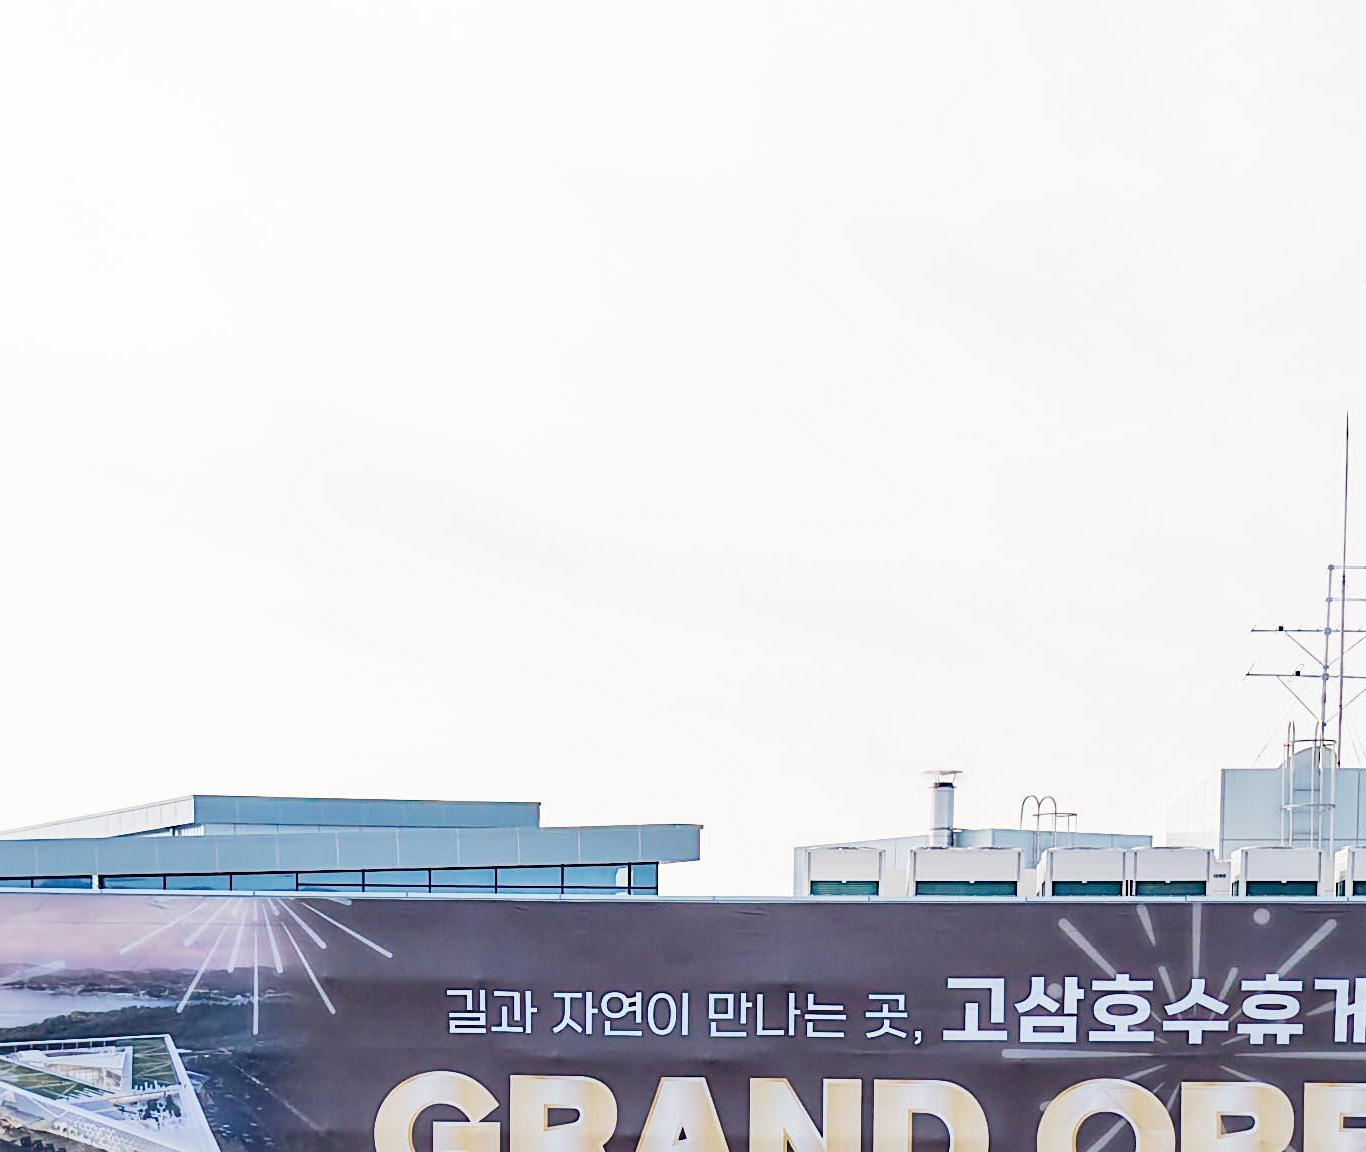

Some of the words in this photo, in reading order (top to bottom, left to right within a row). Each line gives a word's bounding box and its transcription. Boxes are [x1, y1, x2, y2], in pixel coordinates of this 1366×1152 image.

[445, 988, 539, 1035] 길과
[551, 990, 690, 1037] 자연이
[707, 992, 847, 1038] 만나는
[864, 993, 923, 1045] 곳,
